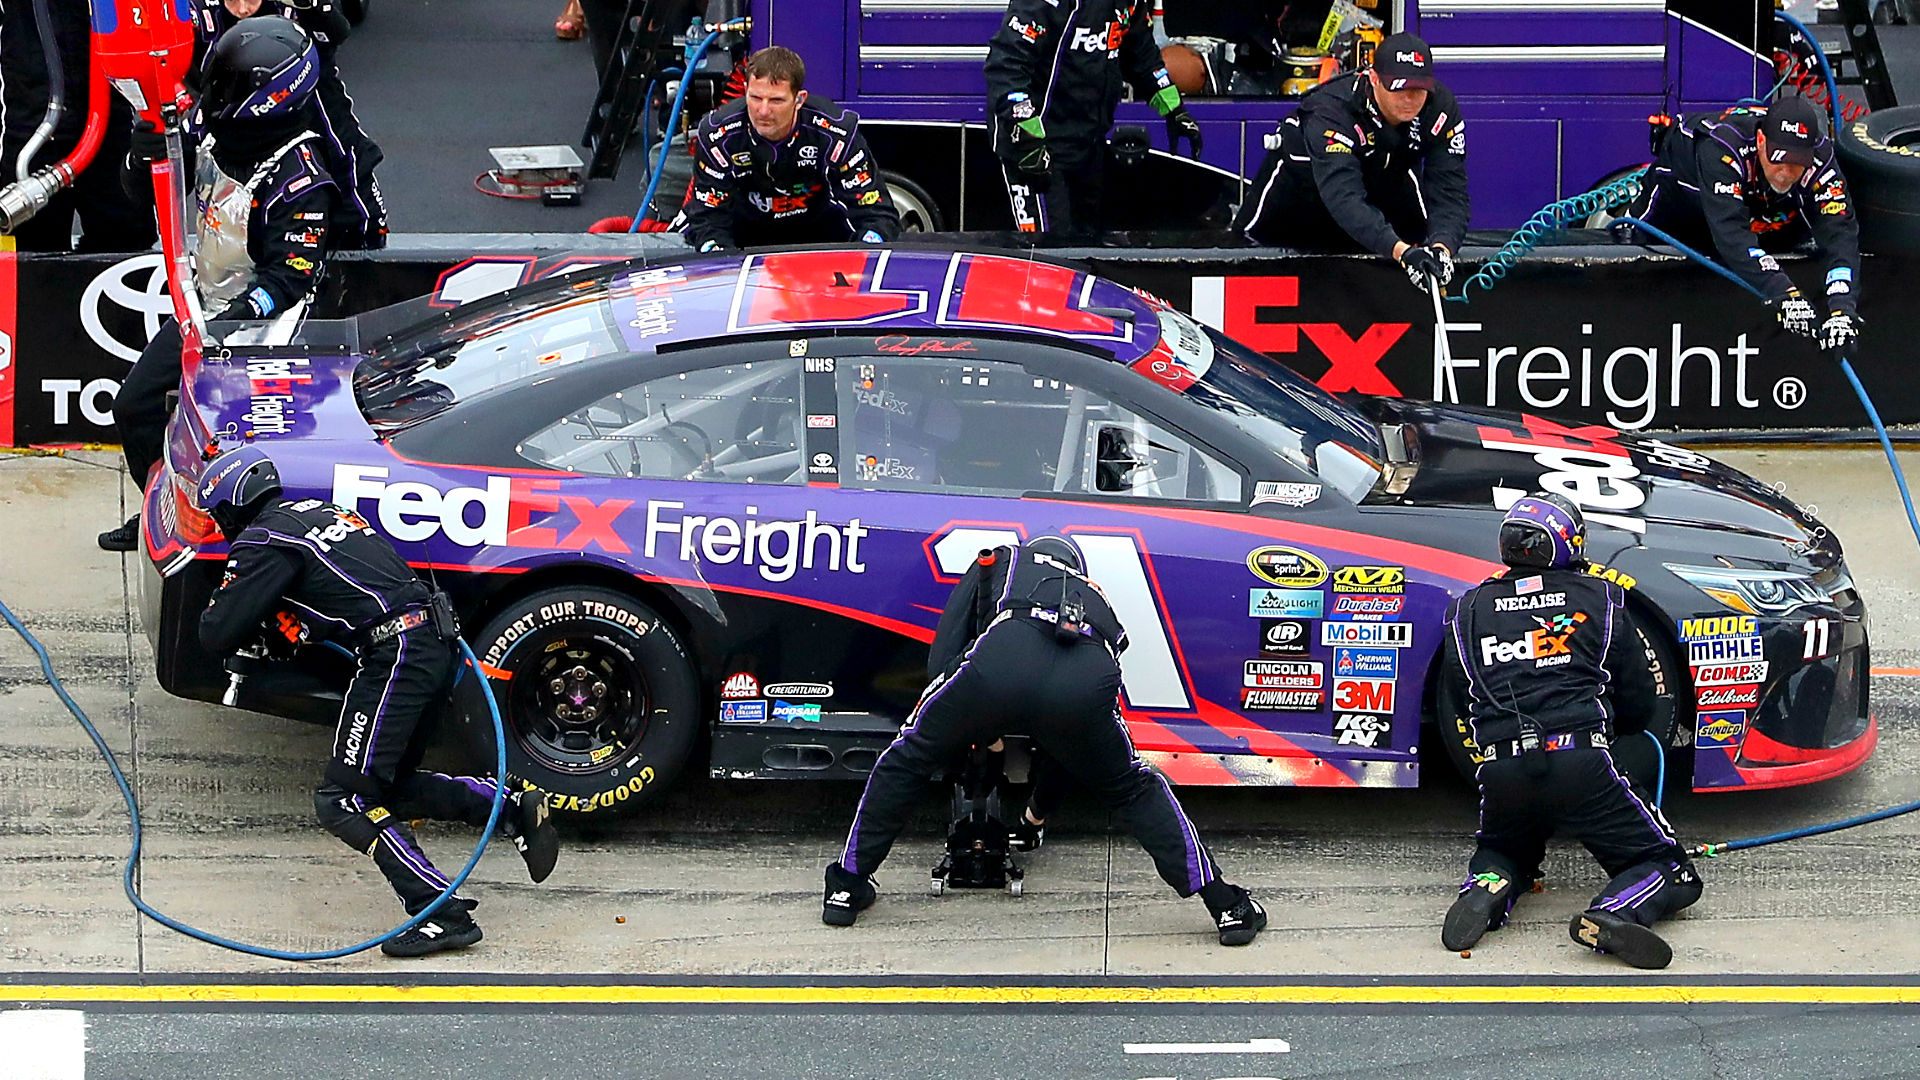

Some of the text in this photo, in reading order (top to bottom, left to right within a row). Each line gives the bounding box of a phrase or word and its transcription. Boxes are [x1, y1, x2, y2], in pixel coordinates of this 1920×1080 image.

[1008, 16, 1038, 40] FedEx
[1070, 21, 1128, 51] FedE
[250, 61, 312, 117] FedEx RACING
[841, 171, 870, 190] FedEx
[774, 208, 808, 219] RACING
[284, 232, 318, 243] FedEx
[804, 358, 835, 373] NHS
[1434, 323, 1759, 430] Freight
[241, 358, 314, 434] FedEx Freight
[809, 466, 837, 474] TOYOTA
[1276, 483, 1320, 497] NASCAR
[333, 464, 868, 582] FedEx Freight
[1545, 514, 1570, 541] FedEx
[1274, 564, 1301, 576] Sprint
[1584, 560, 1637, 590] EAR
[1333, 584, 1403, 593] MECHANIX WEAR
[1291, 600, 1319, 608] LIGHT
[1336, 598, 1400, 612] Duralast
[1494, 592, 1566, 612] NECAISE
[1273, 625, 1297, 640] IR
[1328, 624, 1400, 641] Mobil 1
[1681, 616, 1756, 637] MOOG
[484, 600, 649, 671] UPPORT OUR TROOPS
[1803, 618, 1829, 660] 11
[1480, 628, 1571, 666] FedEx
[1691, 638, 1761, 660] MAHLE
[1355, 662, 1393, 671] WILLIAMS
[1356, 654, 1393, 663] SHERWIN
[1535, 654, 1571, 668] RACING
[1248, 663, 1309, 675] LINCOLN
[1700, 665, 1750, 682] COMP
[724, 674, 758, 691] MAC
[1261, 676, 1315, 686] WELDERS
[770, 686, 827, 695] FREIGHTLINER
[1335, 680, 1392, 711] 3M
[1698, 688, 1757, 706] Edelbrock
[1244, 690, 1320, 709] FLOWMASTER
[772, 707, 820, 716] DOOSAN
[1701, 723, 1742, 736] SUNOCO
[520, 766, 655, 812] GOODYE
